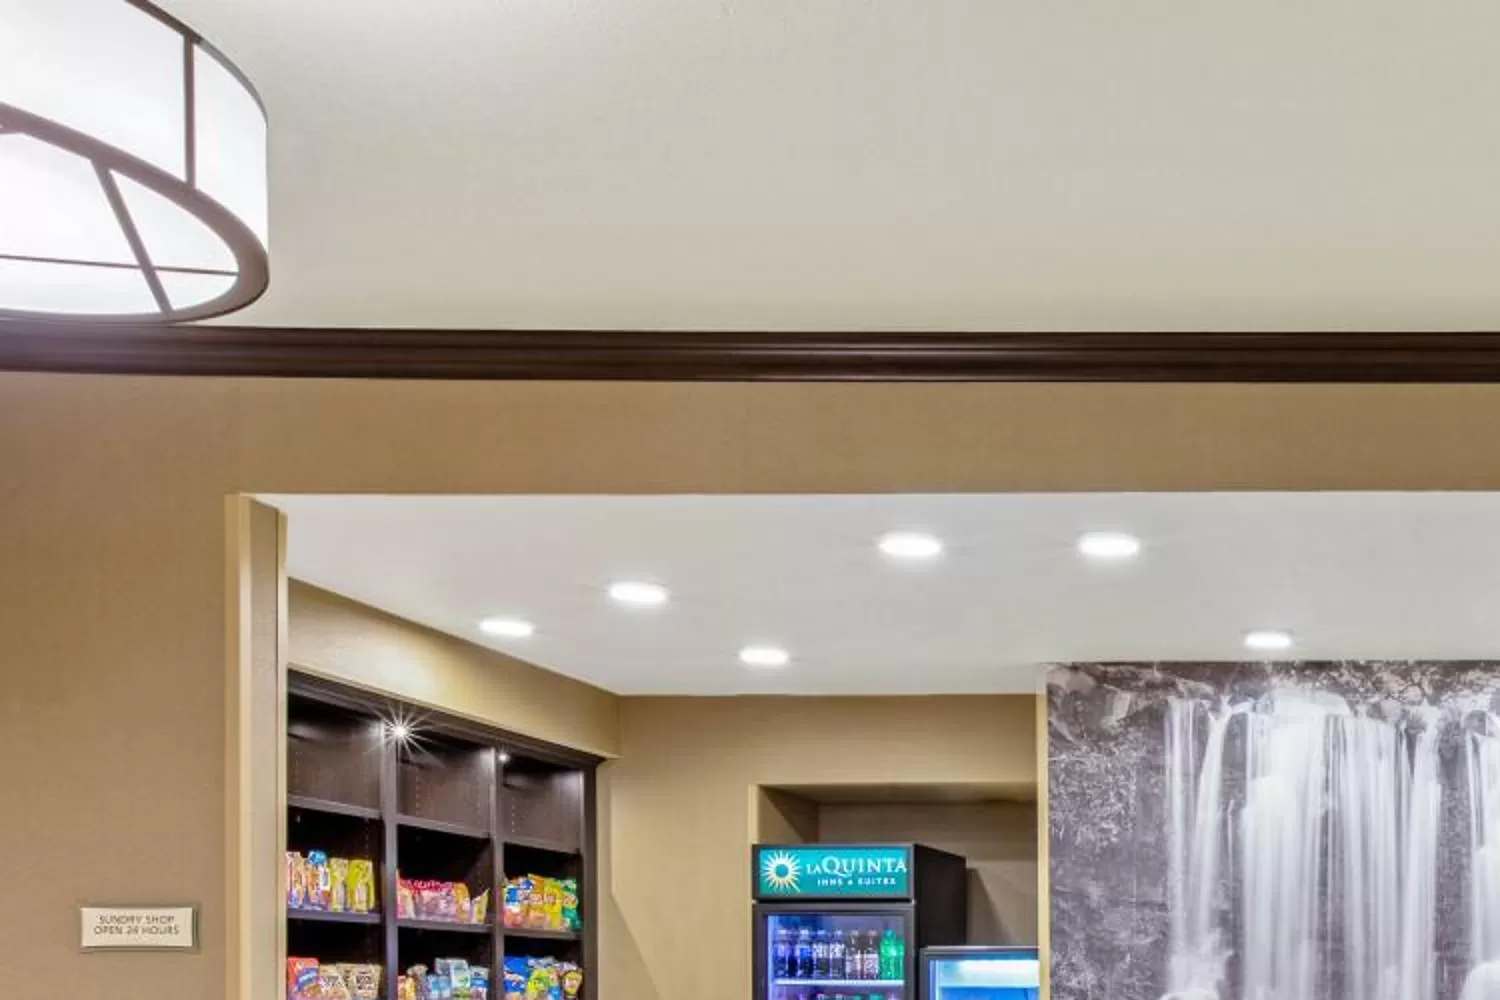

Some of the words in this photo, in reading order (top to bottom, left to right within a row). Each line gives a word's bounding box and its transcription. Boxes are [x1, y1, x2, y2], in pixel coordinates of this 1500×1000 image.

[145, 914, 175, 925] SHOP
[93, 925, 123, 936] OPEN
[126, 926, 139, 936] 24
[141, 925, 181, 936] HOURS
